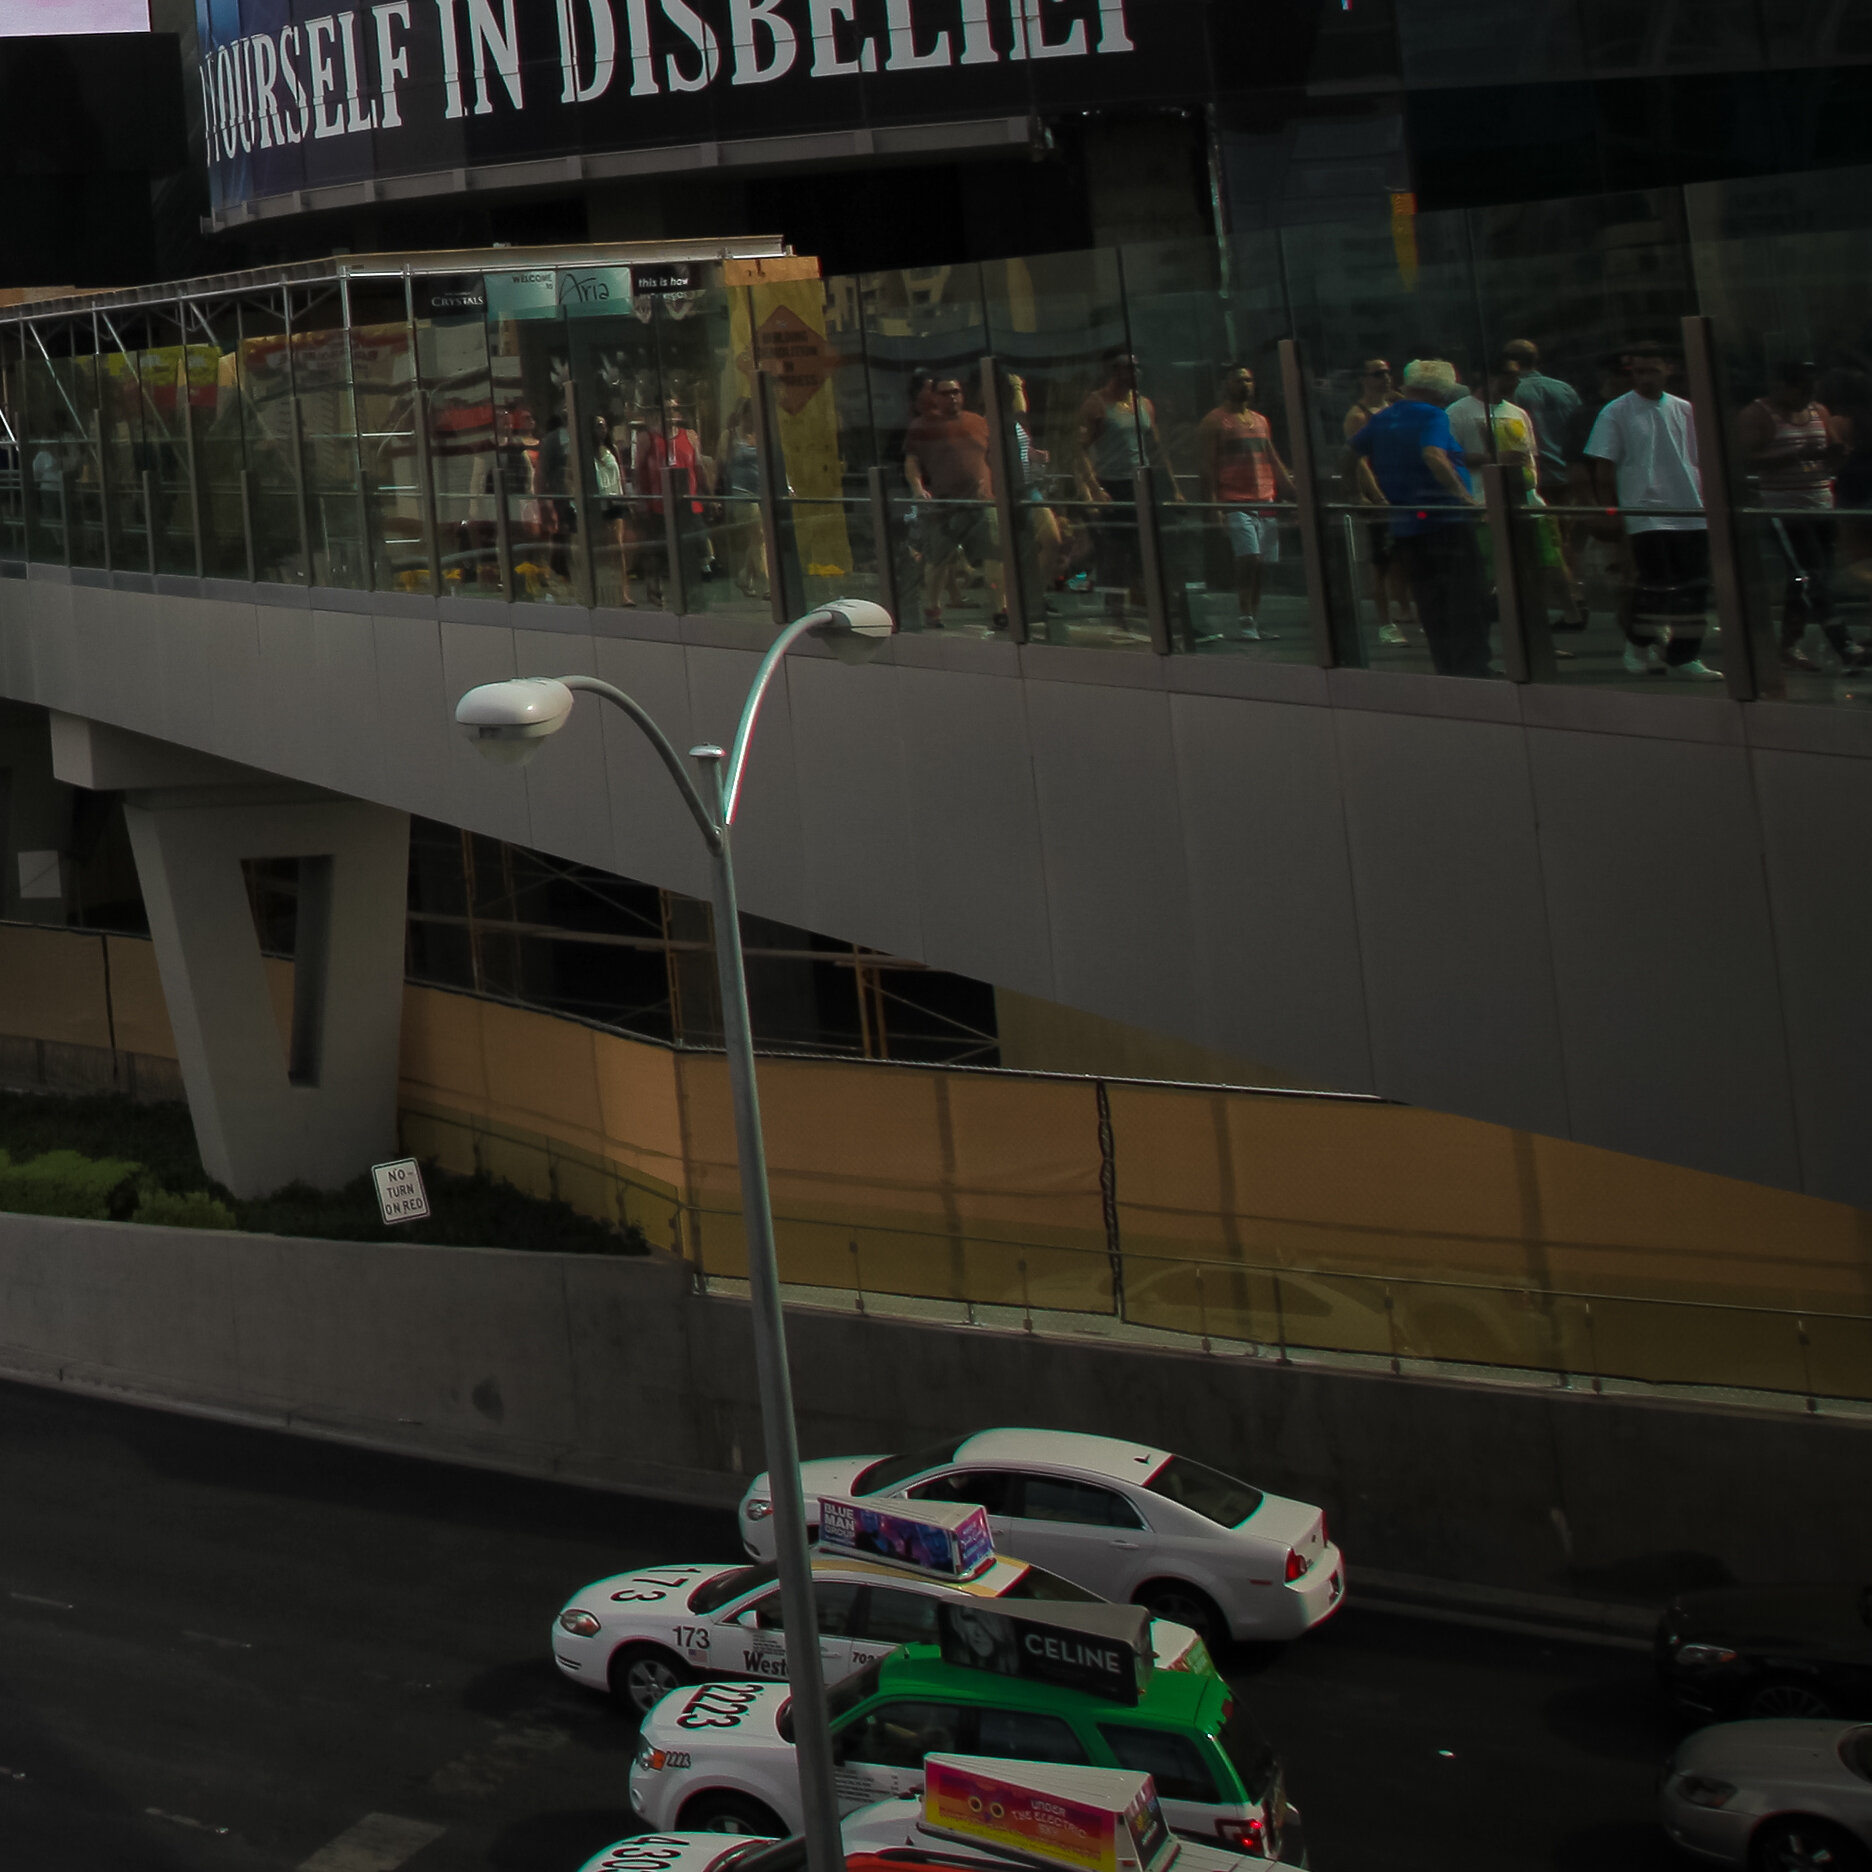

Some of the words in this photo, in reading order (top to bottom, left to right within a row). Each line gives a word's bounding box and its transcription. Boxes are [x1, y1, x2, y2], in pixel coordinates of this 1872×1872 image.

[558, 273, 609, 305] Aria
[638, 278, 657, 288] this
[659, 278, 667, 287] is
[431, 295, 484, 307] CRYSTALS
[386, 1183, 415, 1198] TURN
[386, 1203, 401, 1215] ON
[403, 1198, 423, 1211] RED
[824, 1503, 854, 1520] BLUE
[824, 1514, 856, 1531] MAN
[673, 1625, 711, 1648] 173
[1024, 1633, 1122, 1674] CELINE
[743, 1650, 788, 1677] West
[676, 1684, 764, 1729] 2223
[665, 1751, 691, 1768] 2223
